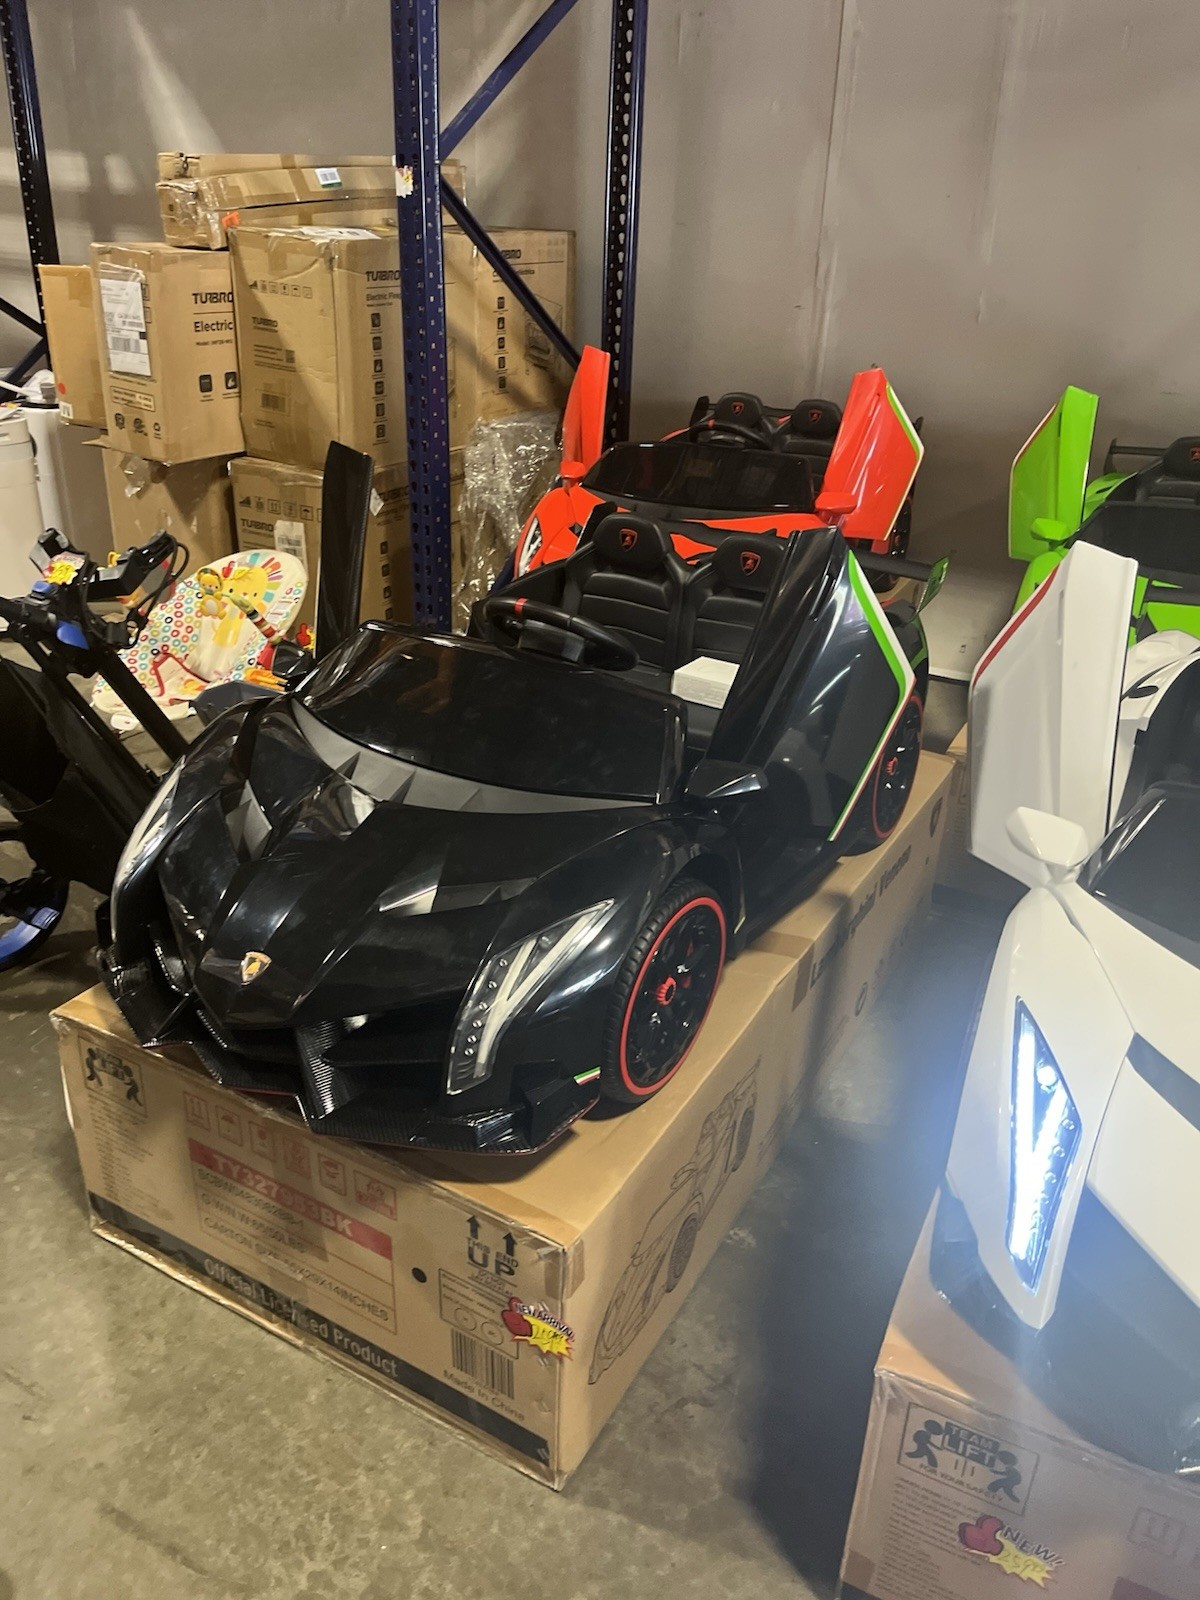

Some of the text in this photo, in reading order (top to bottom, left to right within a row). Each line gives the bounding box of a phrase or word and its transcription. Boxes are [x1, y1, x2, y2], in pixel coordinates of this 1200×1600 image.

[194, 320, 234, 333] Electric
[240, 518, 274, 532] TURBRO
[467, 1246, 515, 1277] UP
[204, 1257, 257, 1298] Official
[333, 1328, 399, 1378] Product
[443, 1369, 474, 1394] Made
[490, 1398, 525, 1422] China
[943, 1433, 995, 1465] LIFT
[950, 1425, 994, 1450] TEAM
